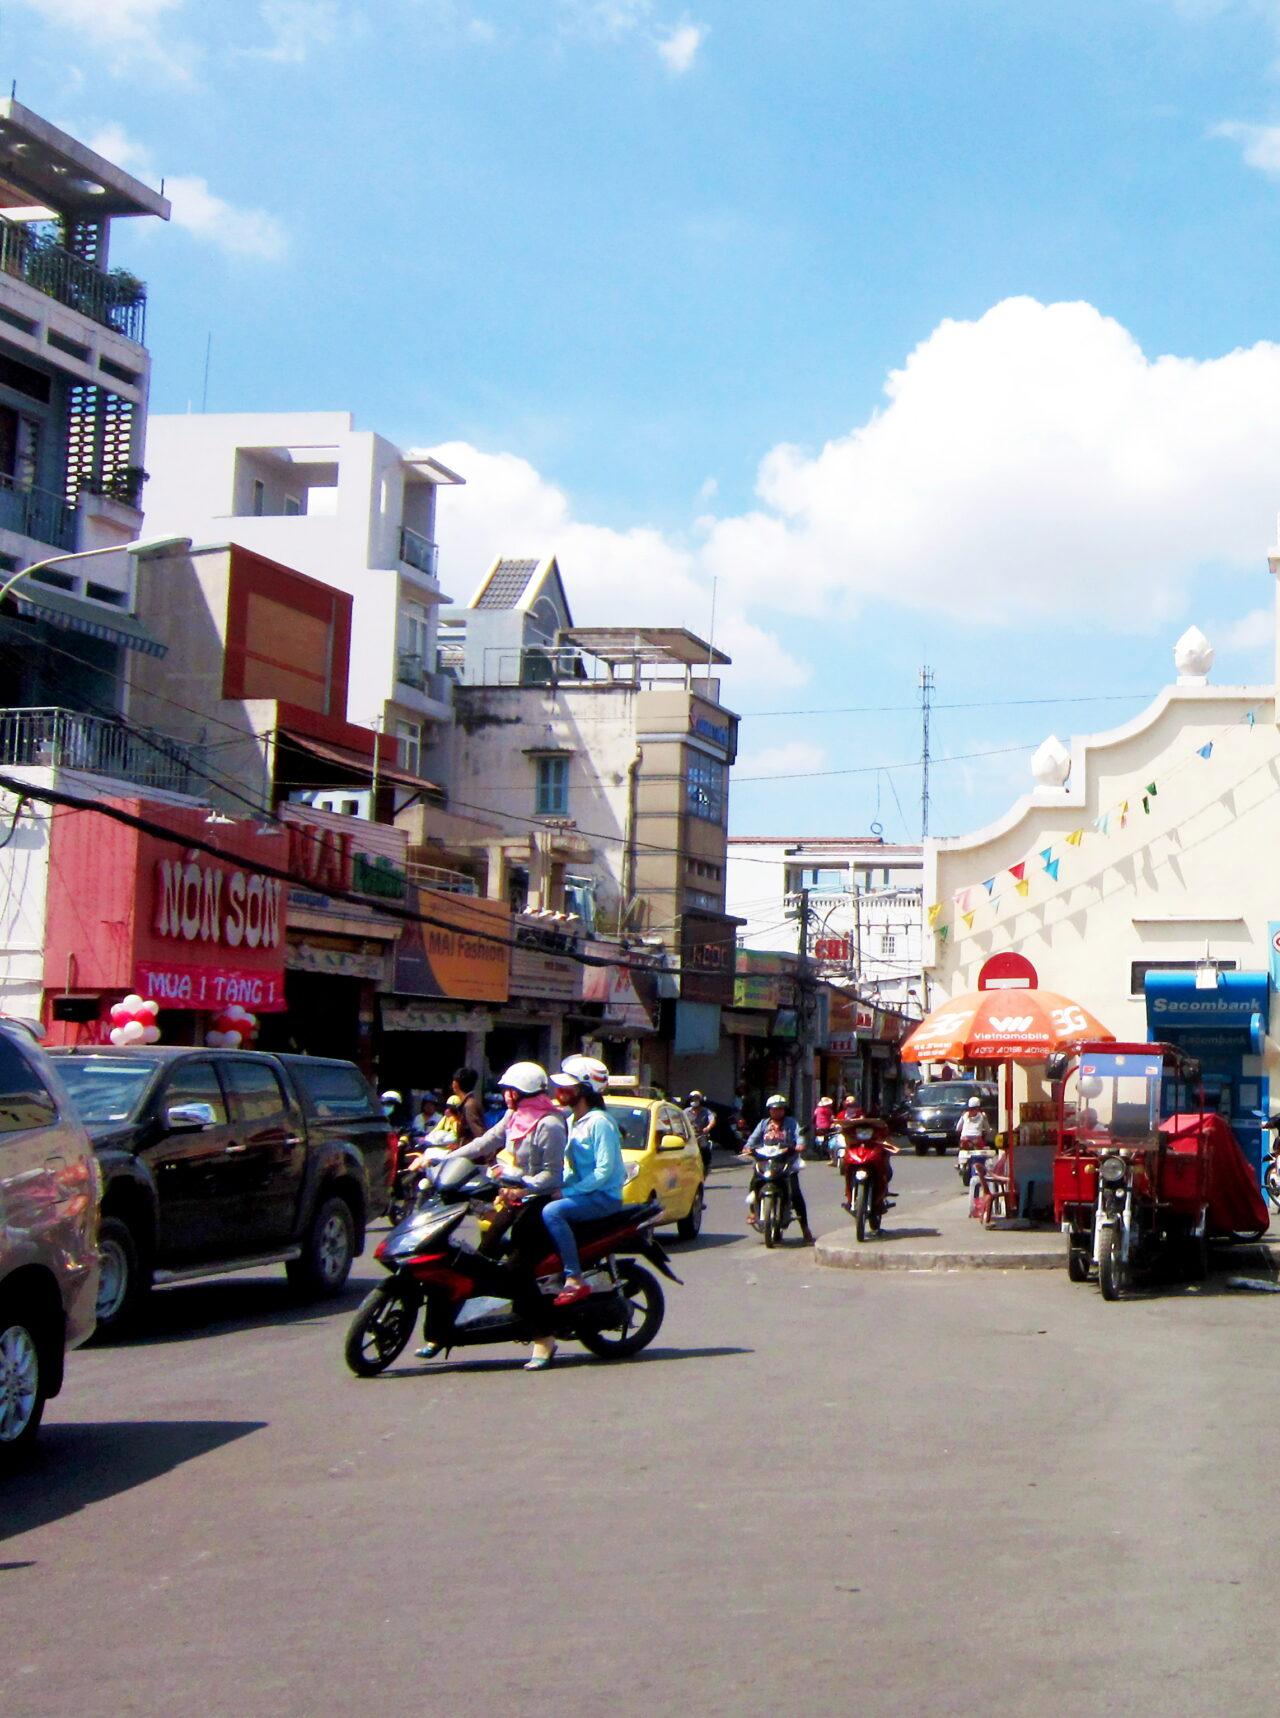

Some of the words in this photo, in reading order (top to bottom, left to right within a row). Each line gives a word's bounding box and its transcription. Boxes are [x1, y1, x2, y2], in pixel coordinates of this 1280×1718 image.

[158, 850, 223, 943] NÓN
[226, 871, 281, 948] SƠN
[147, 972, 192, 999] MUA
[1153, 998, 1261, 1013] Sacombank
[1050, 1005, 1088, 1036] 3G
[974, 1033, 1049, 1041] Vietnamobile
[1178, 1034, 1247, 1046] Sacombank
